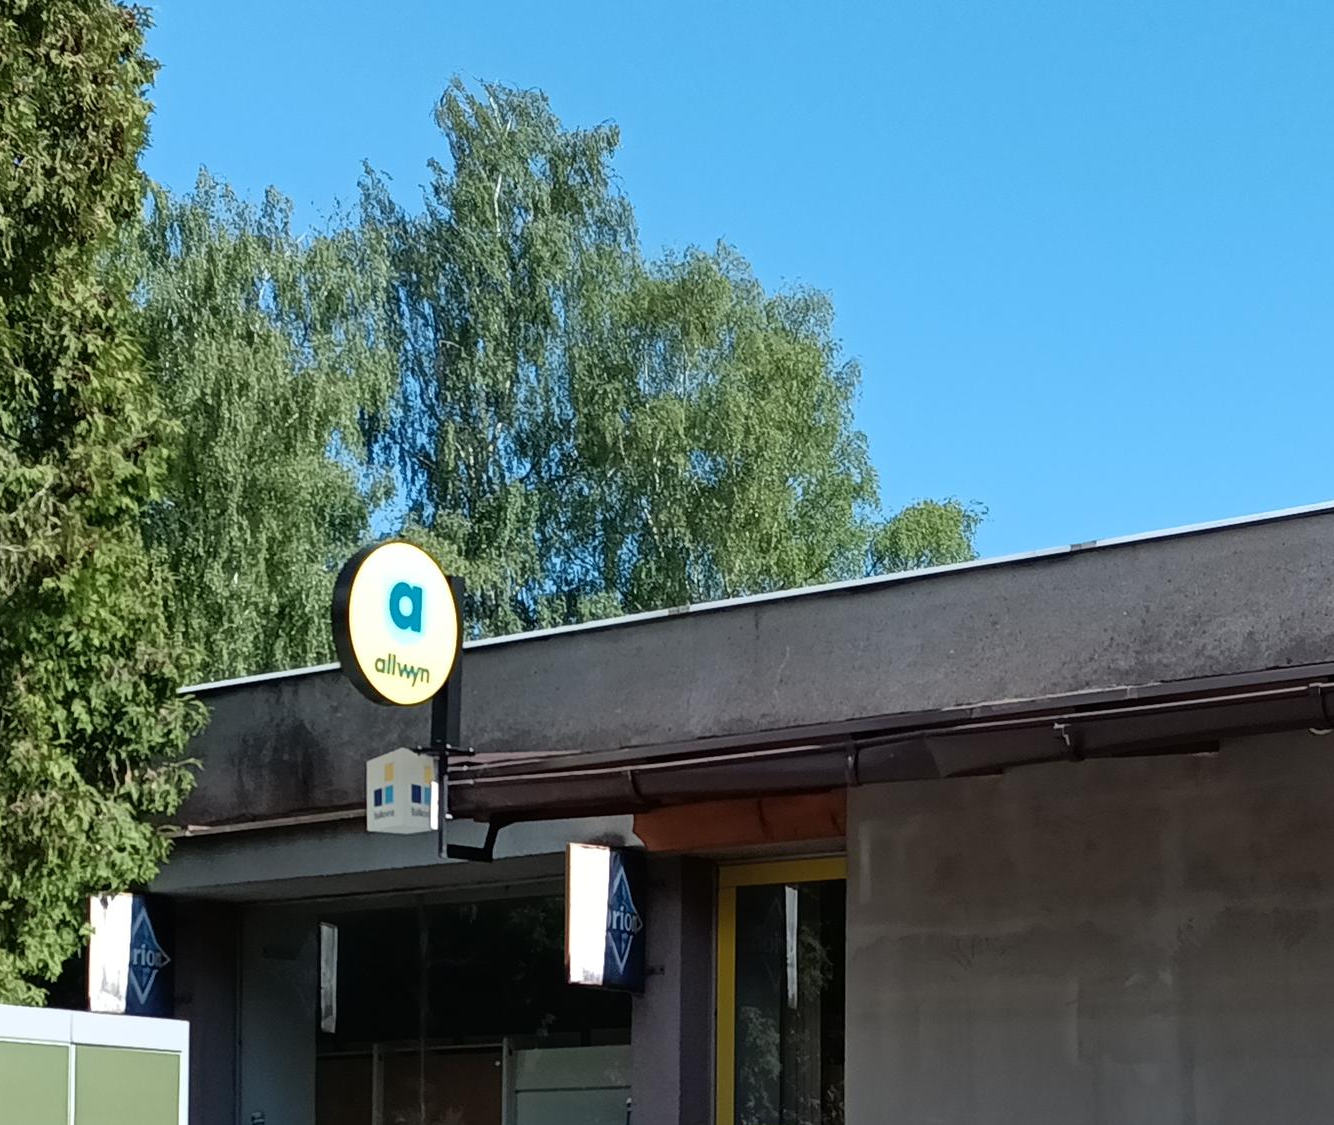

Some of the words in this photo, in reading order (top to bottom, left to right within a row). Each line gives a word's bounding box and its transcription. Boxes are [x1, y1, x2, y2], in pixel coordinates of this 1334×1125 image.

[389, 581, 423, 633] a
[374, 653, 430, 687] allwyn
[607, 905, 638, 934] rion
[132, 943, 161, 968] rion
